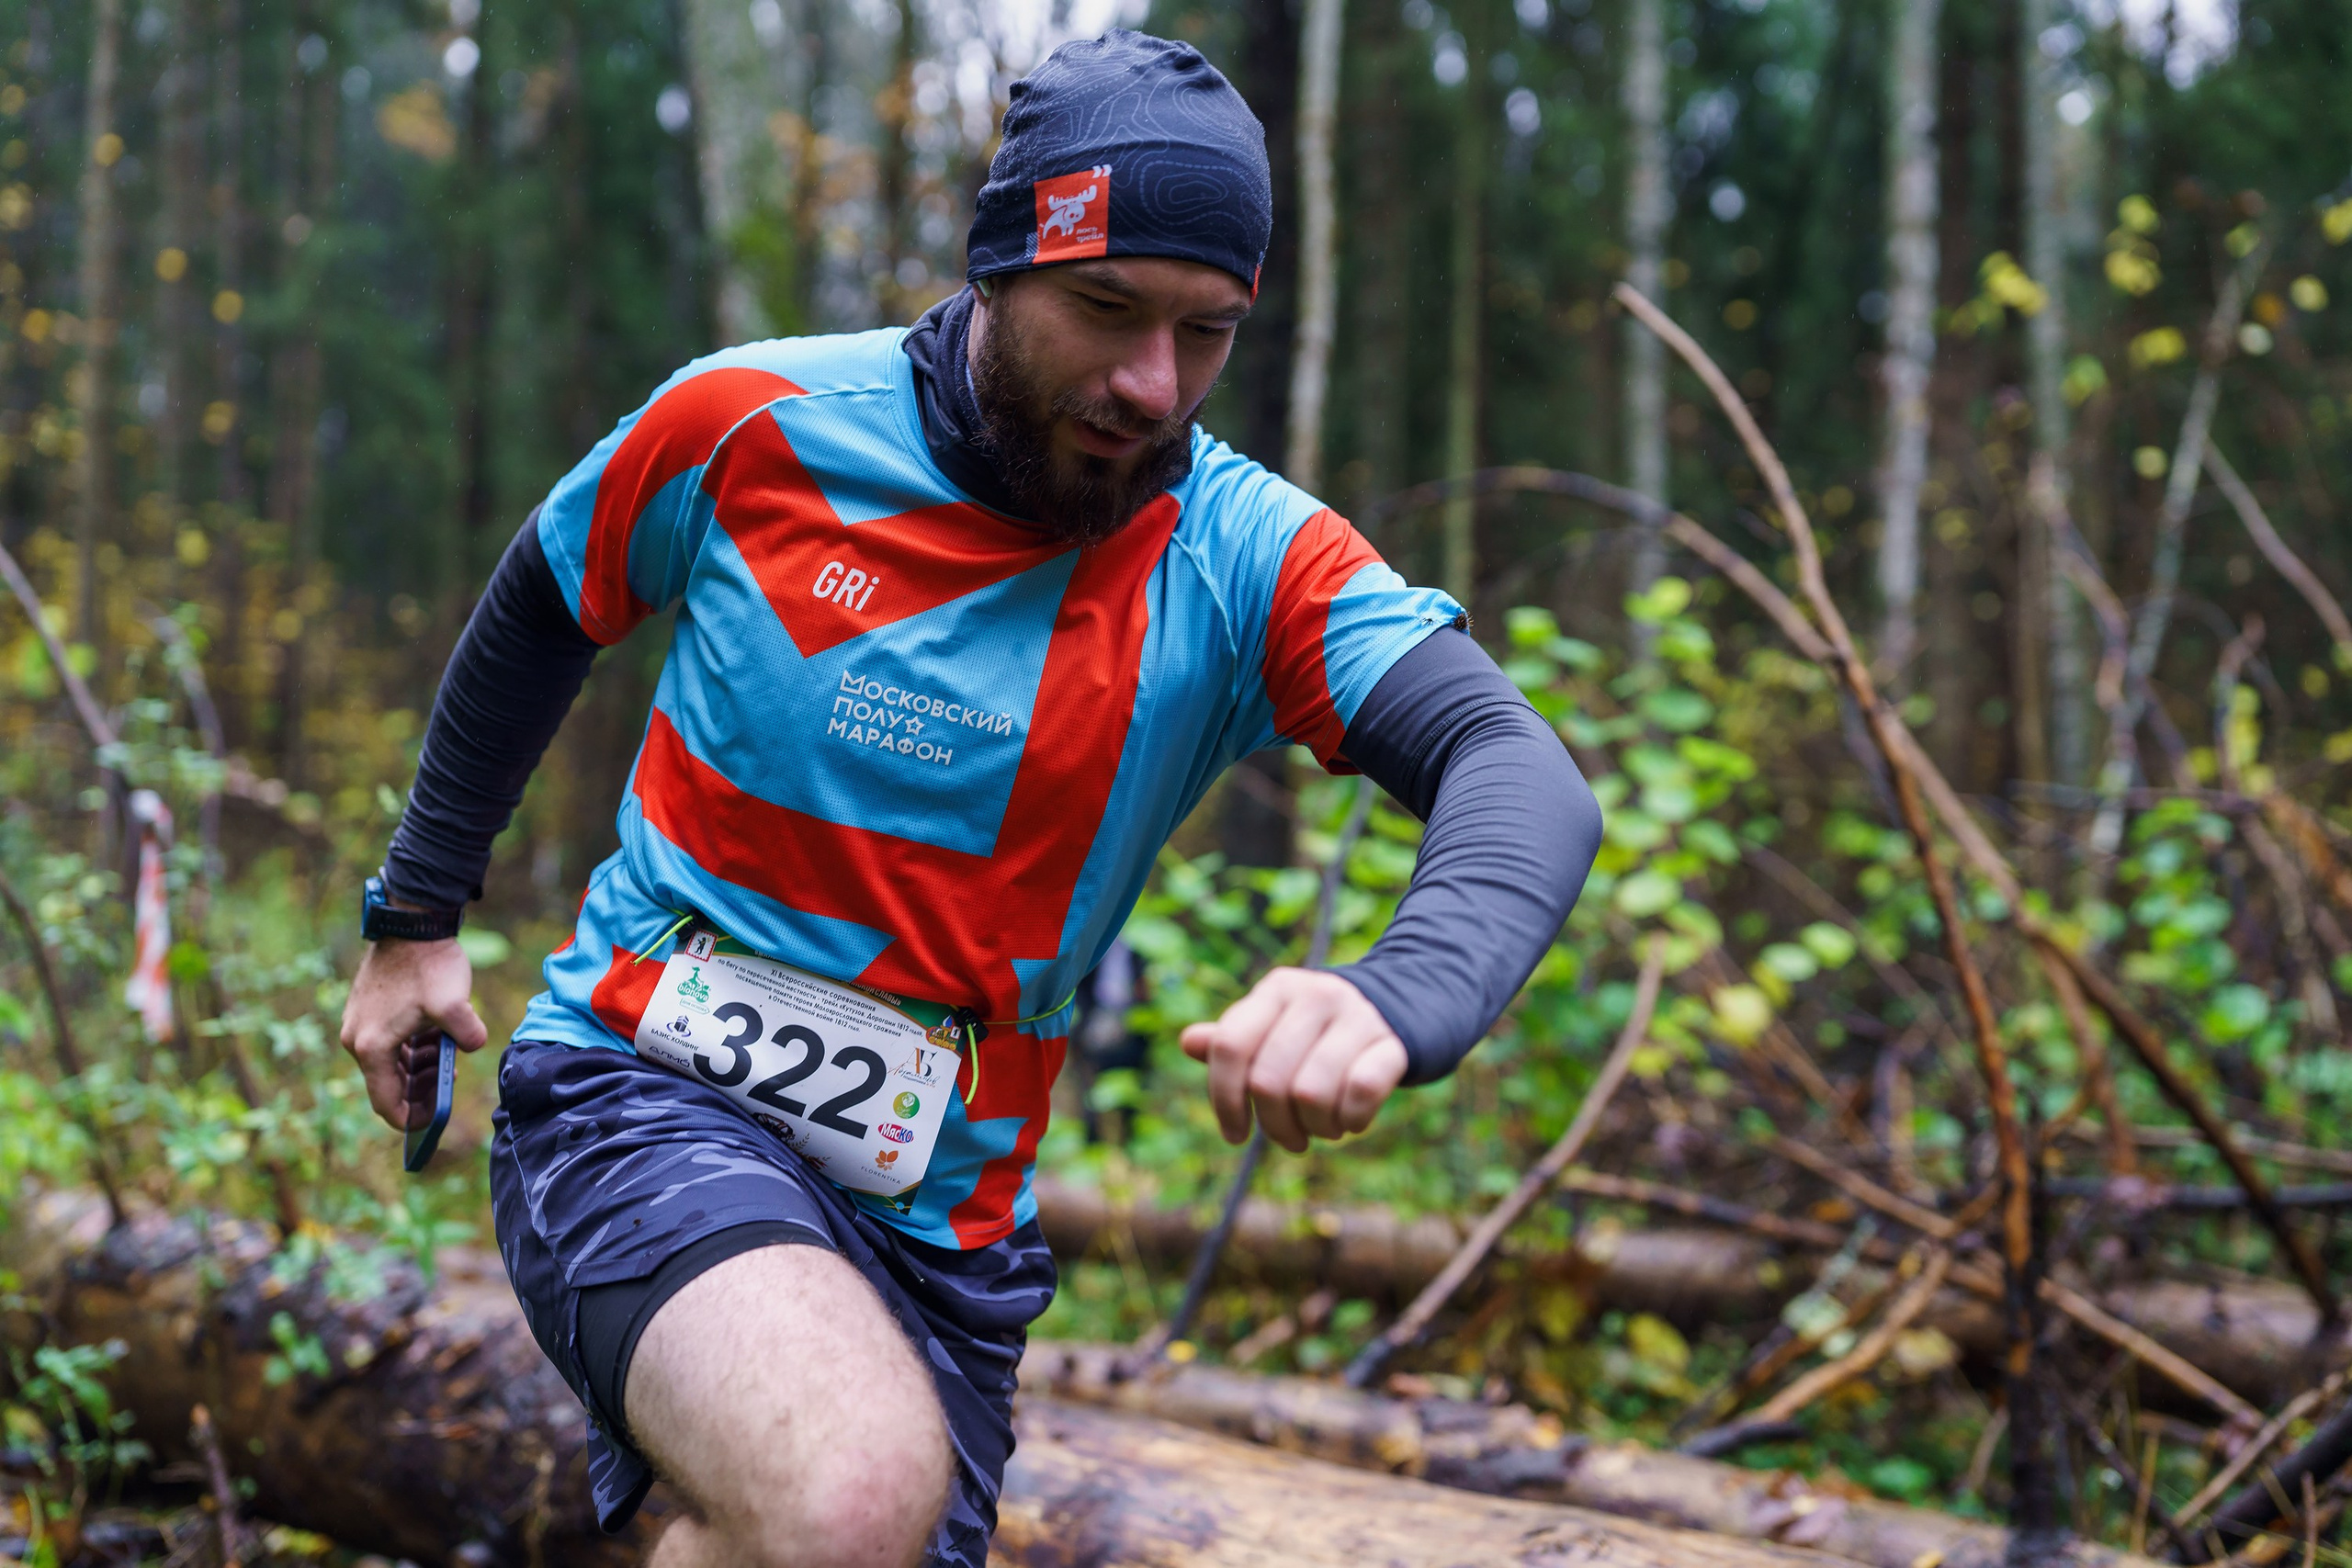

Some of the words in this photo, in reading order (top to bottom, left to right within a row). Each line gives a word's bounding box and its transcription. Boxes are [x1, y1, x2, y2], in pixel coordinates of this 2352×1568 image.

[827, 717, 953, 766] МАРАФОН
[678, 984, 709, 1001] bionova
[726, 960, 739, 972] бегу
[746, 969, 786, 988] пересеченной
[786, 985, 817, 1000] местности
[821, 998, 838, 1008] трейл
[866, 1012, 896, 1027] Дорогами
[897, 1022, 910, 1032] 1812
[735, 973, 772, 991] посвященные
[773, 988, 793, 1000] памяти
[793, 996, 813, 1008] героев
[873, 1023, 901, 1037] сражения
[773, 995, 815, 1016] Отечественной
[816, 1013, 833, 1022] войне
[834, 1018, 848, 1028] 1812
[777, 971, 828, 996] Всероссийские
[829, 991, 876, 1012] соревнования
[650, 1028, 672, 1041] БАЗИС
[693, 1001, 887, 1140] 322
[860, 1166, 901, 1185] FLORENTIKA
